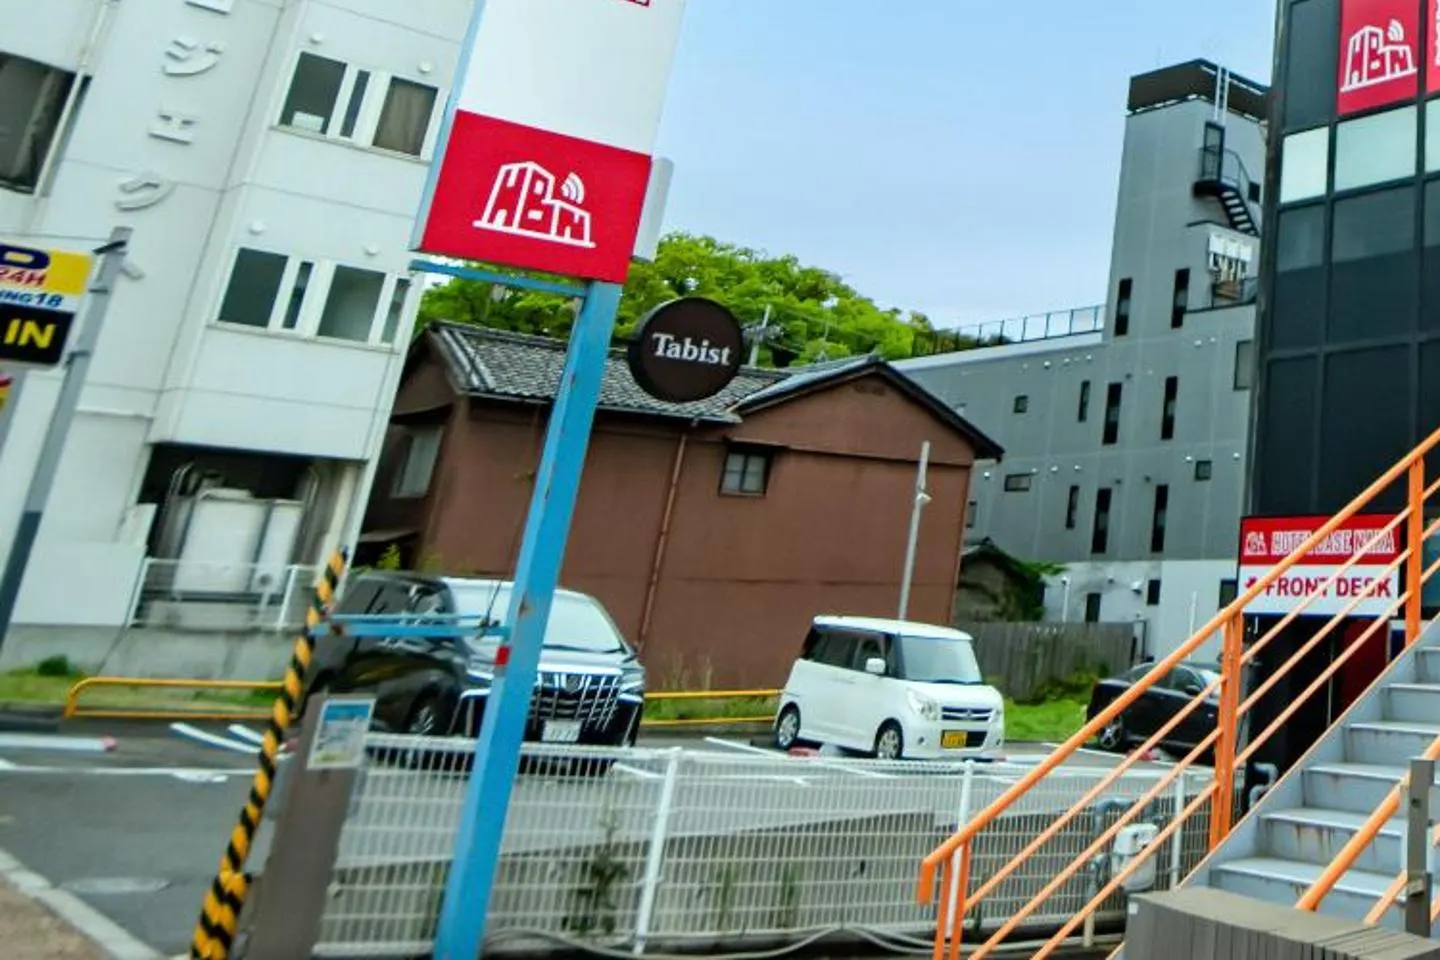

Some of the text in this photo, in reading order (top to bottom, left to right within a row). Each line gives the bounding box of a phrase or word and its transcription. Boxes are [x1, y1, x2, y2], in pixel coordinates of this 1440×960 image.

[5, 318, 56, 349] IN
[652, 333, 732, 366] Tabist
[1335, 577, 1392, 597] DESK
